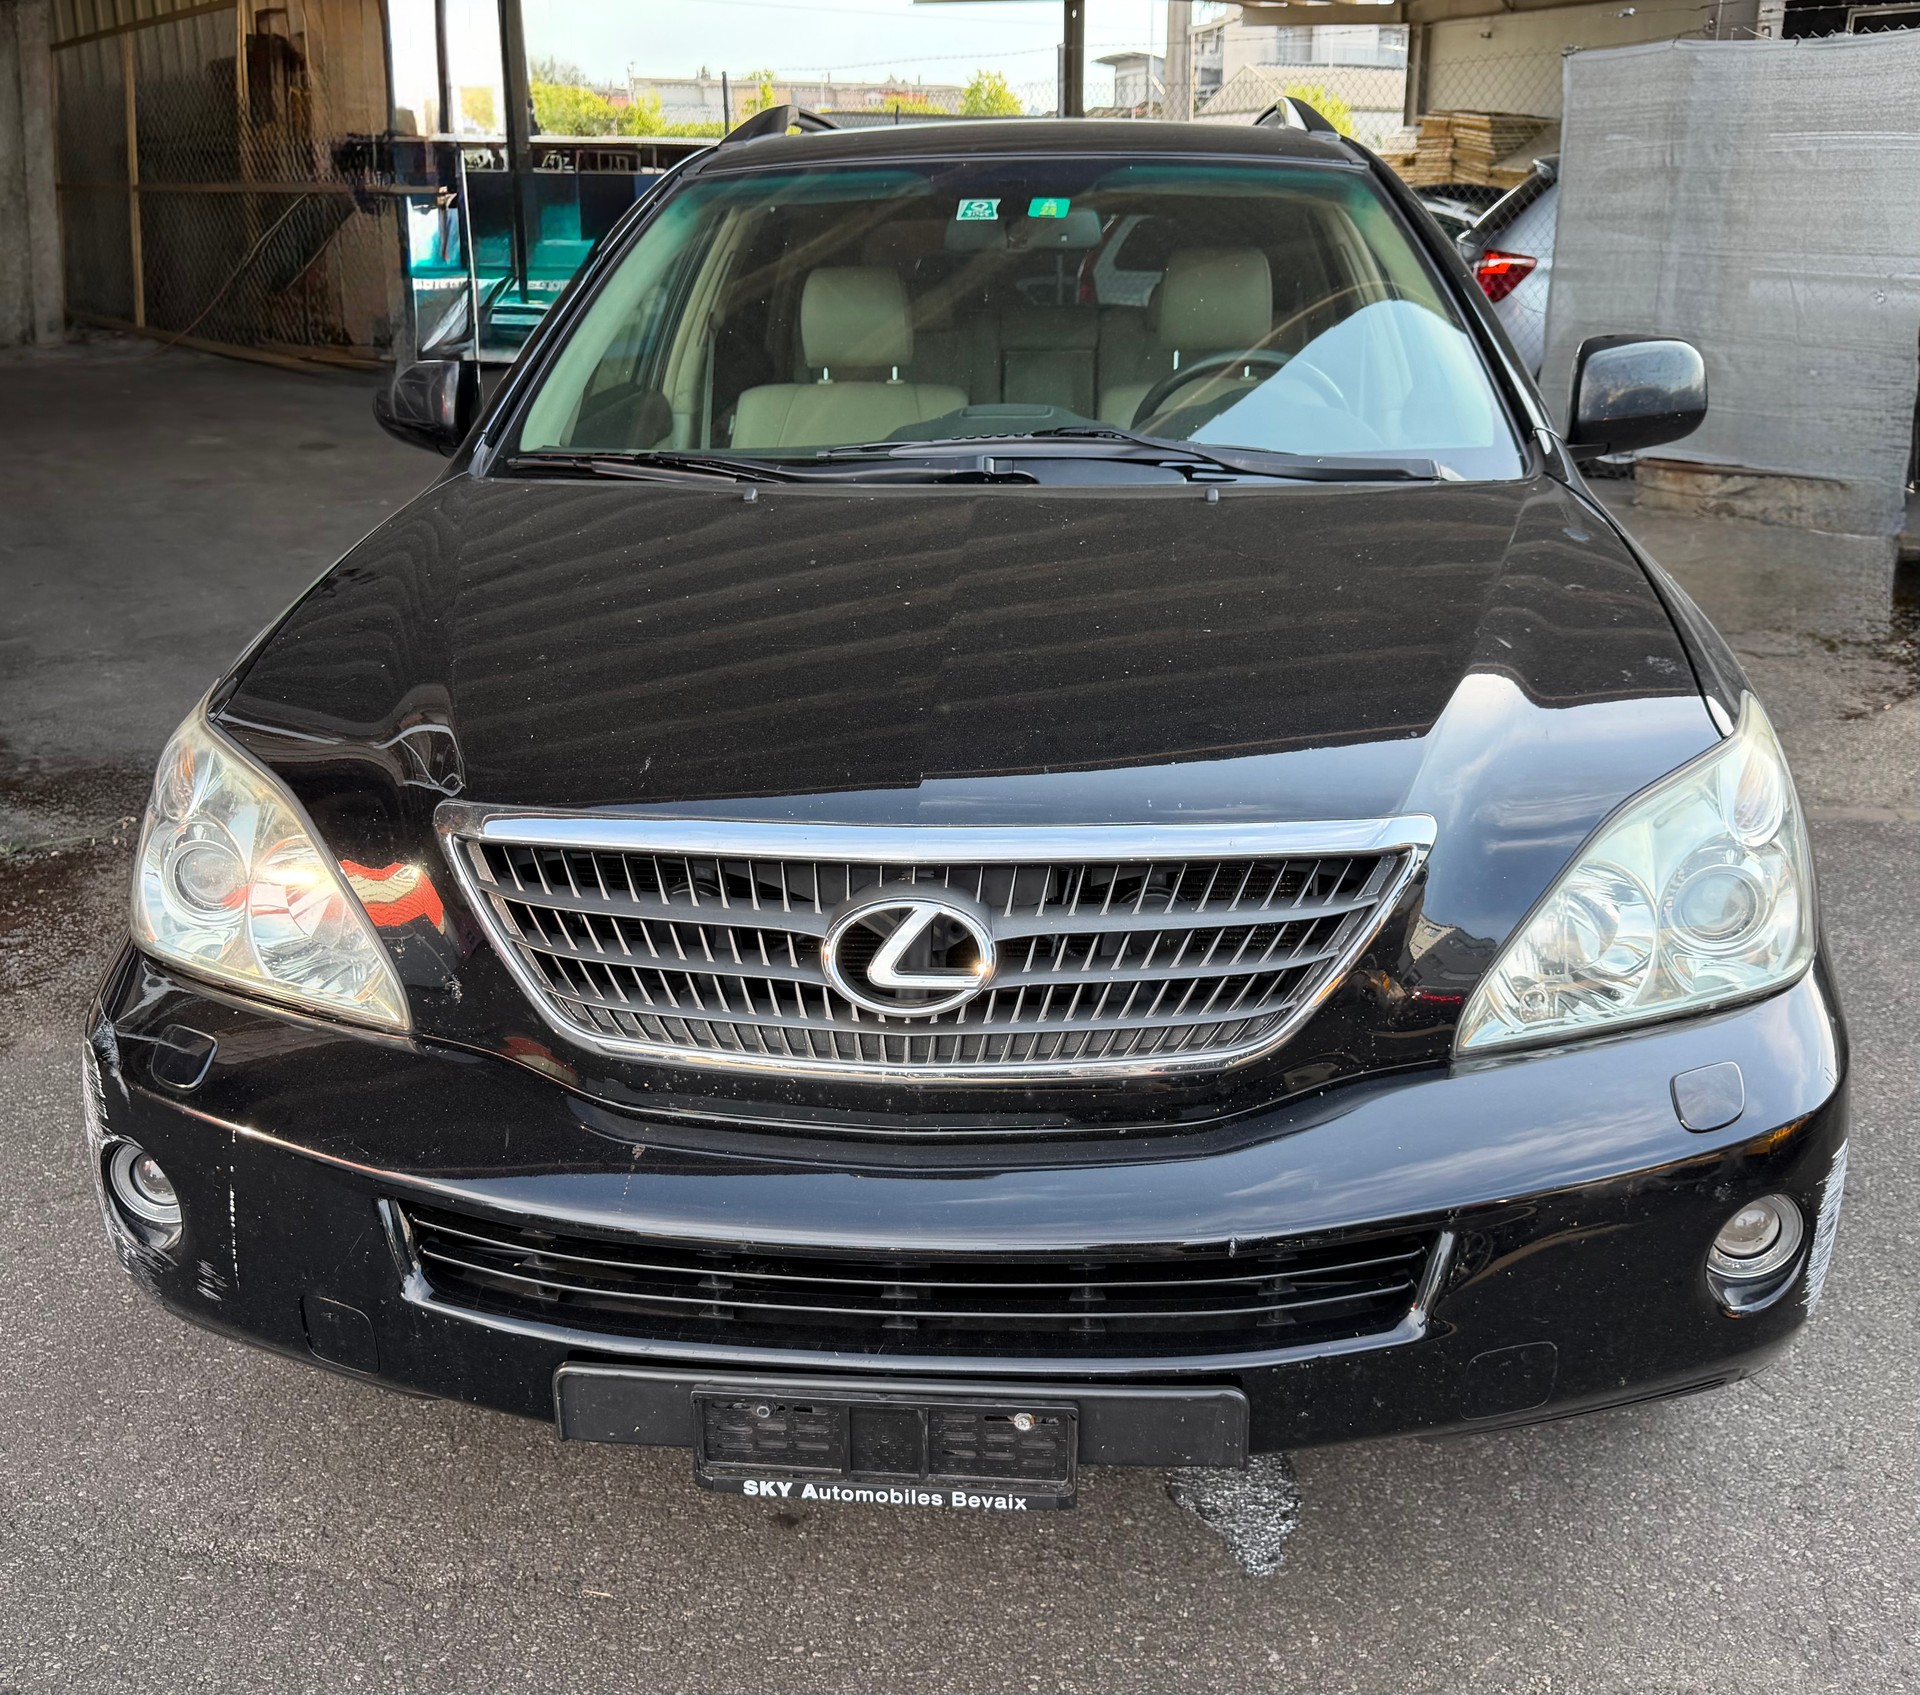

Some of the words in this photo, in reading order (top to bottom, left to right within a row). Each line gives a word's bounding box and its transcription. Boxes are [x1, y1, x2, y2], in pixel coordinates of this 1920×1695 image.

[743, 1480, 793, 1497] SKY
[801, 1483, 944, 1506] Automobiles
[951, 1491, 1027, 1510] Bevaix
